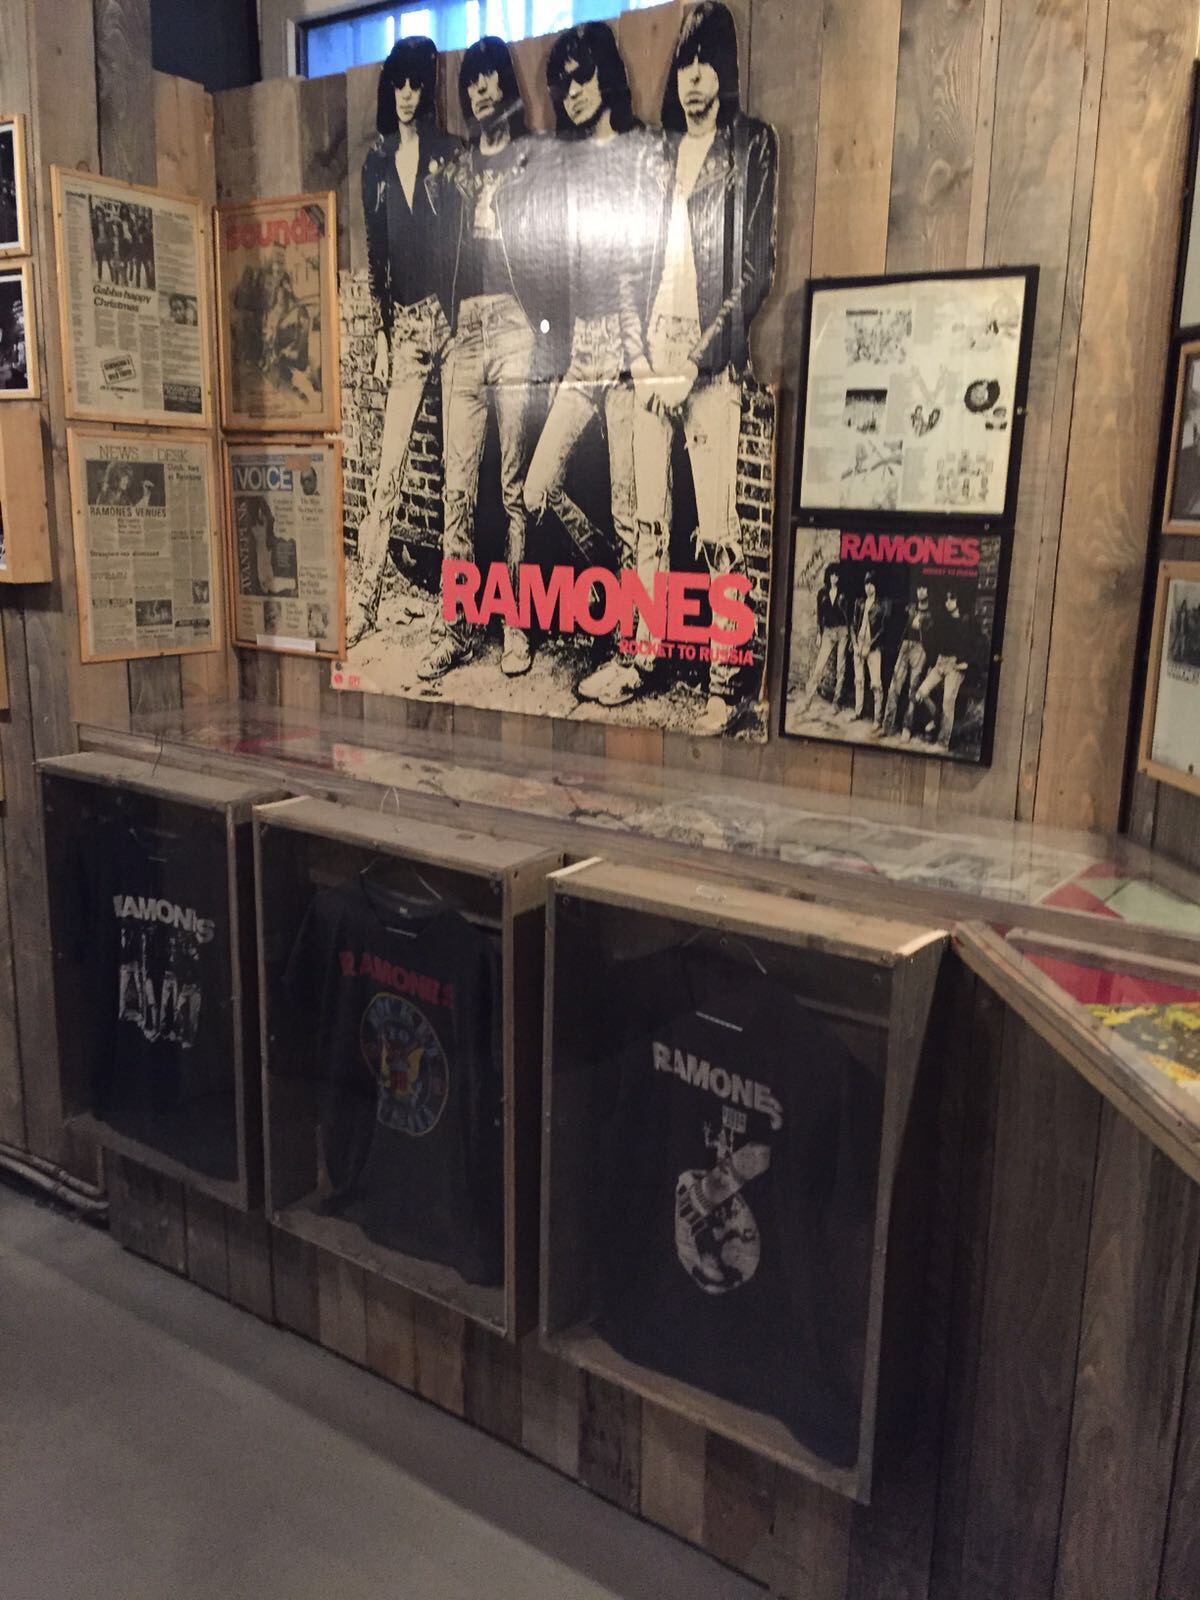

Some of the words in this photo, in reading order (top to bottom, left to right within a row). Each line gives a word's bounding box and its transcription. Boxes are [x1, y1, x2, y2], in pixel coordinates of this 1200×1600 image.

[93, 284, 123, 298] Gabba
[124, 290, 152, 304] happy
[94, 296, 139, 312] Christmas
[99, 445, 140, 460] NEWS
[156, 447, 188, 462] DESK
[236, 466, 293, 491] VOICE
[90, 506, 132, 517] RAMONES
[135, 507, 167, 518] VENUES
[841, 532, 980, 566] RAMONES
[441, 559, 757, 646] RAMONES
[619, 639, 674, 658] ROCKET
[677, 644, 697, 660] TO
[700, 647, 754, 666] RUSSIA
[652, 1040, 783, 1131] RAMONES
